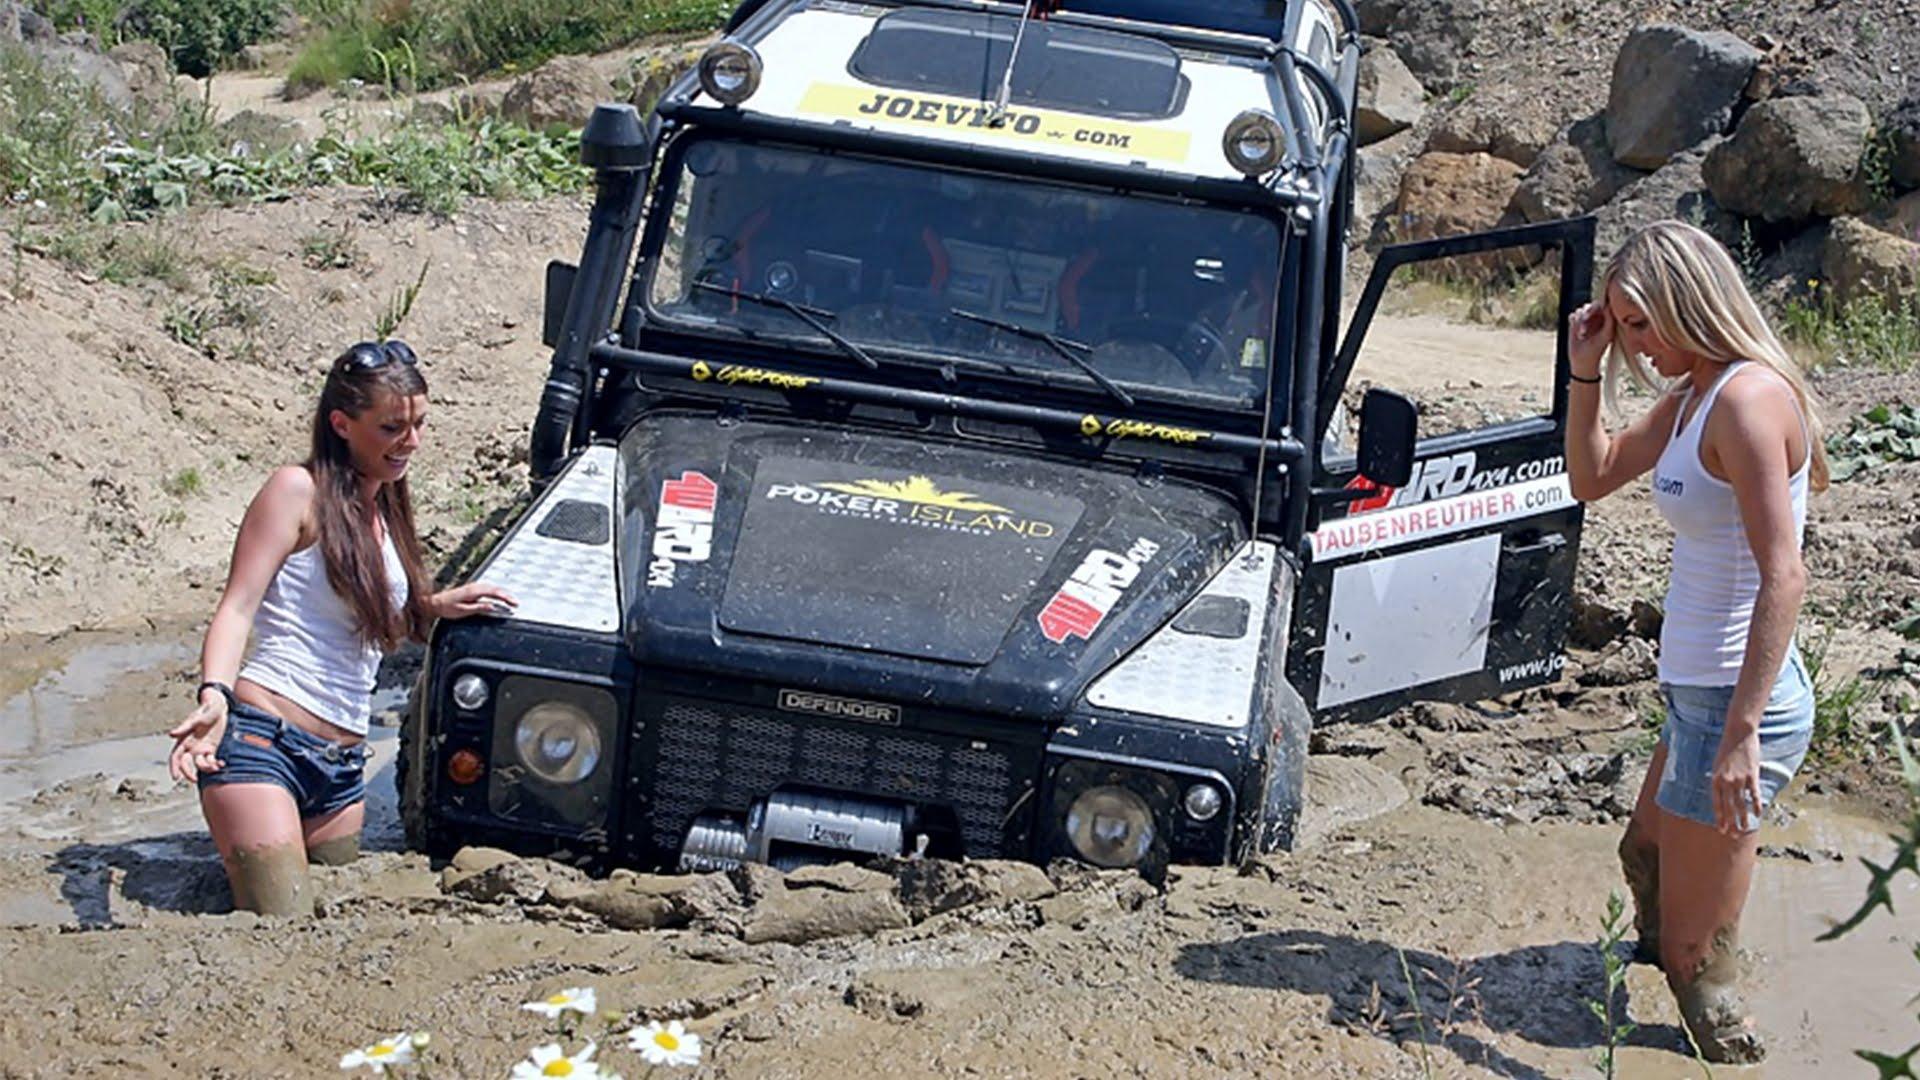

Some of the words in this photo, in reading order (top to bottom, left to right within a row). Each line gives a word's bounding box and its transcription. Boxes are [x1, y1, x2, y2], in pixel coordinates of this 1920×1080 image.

[1074, 129, 1131, 148] COM
[767, 484, 900, 515] POKER
[910, 504, 1054, 538] ISLAND
[785, 694, 893, 721] DEFENDER
